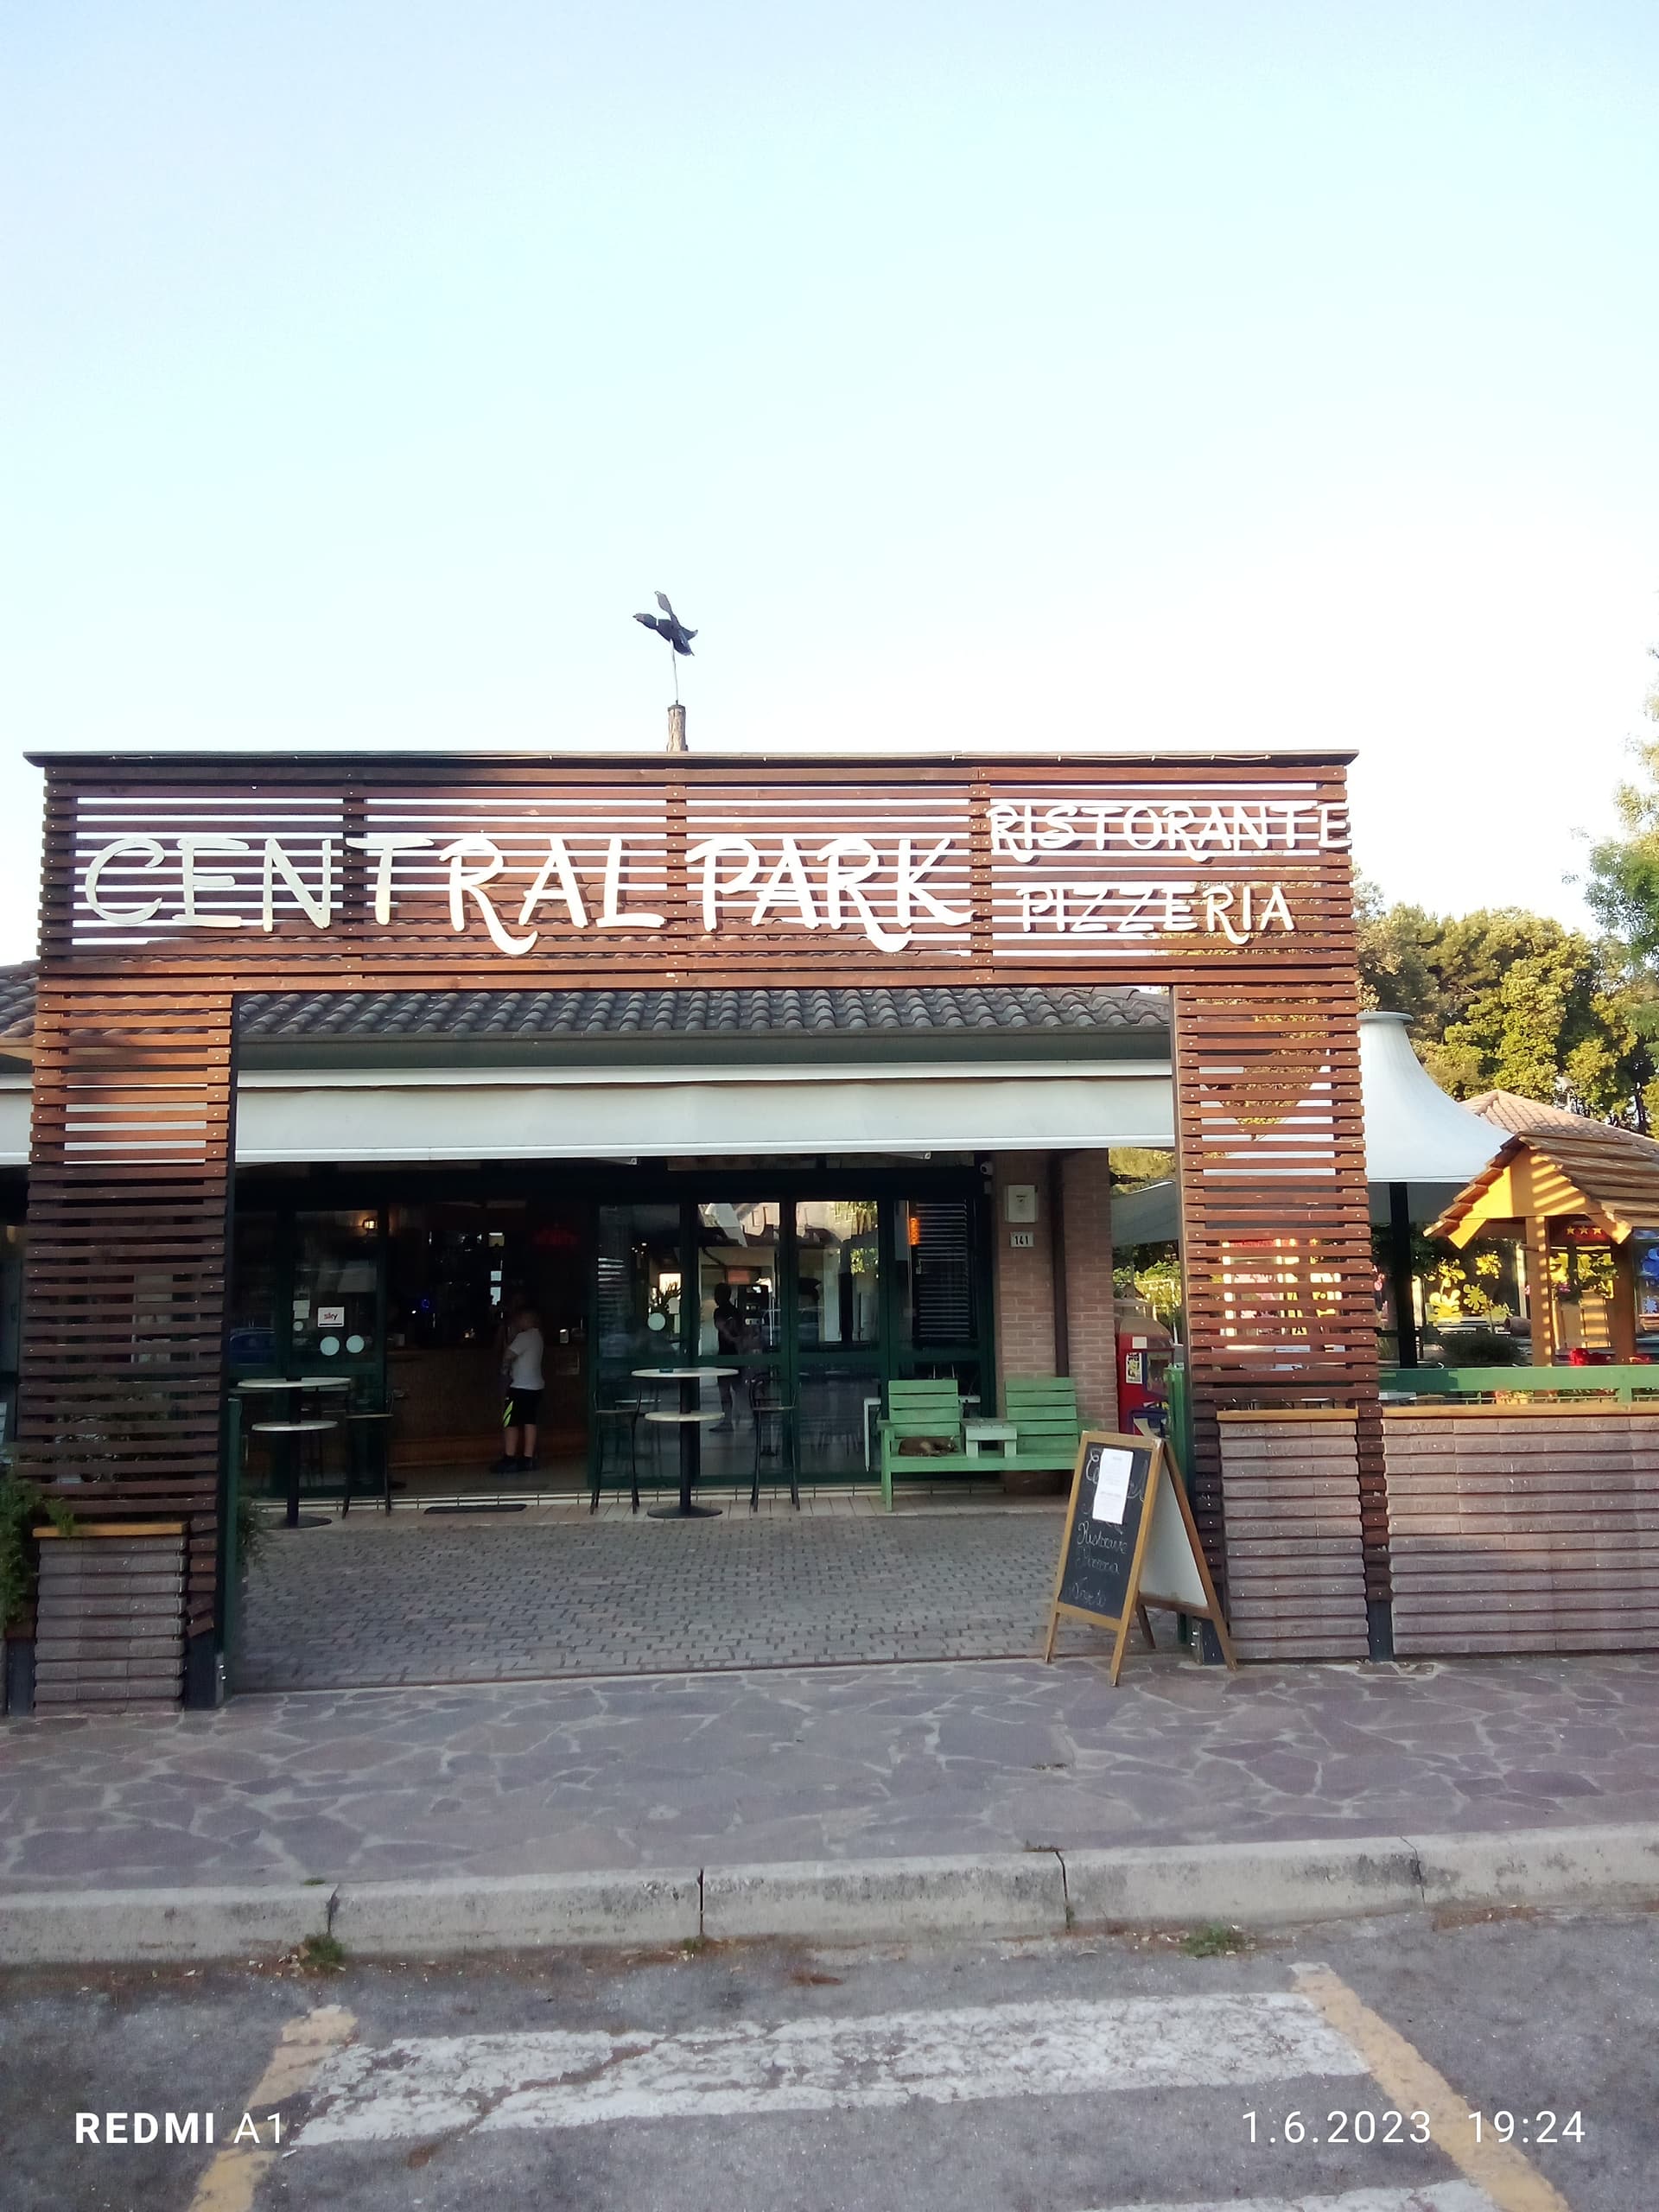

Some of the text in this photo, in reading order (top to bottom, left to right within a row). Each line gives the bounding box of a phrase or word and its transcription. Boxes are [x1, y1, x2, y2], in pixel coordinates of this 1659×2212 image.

[985, 802, 1352, 862] RISTORANTE
[86, 836, 978, 956] CENTRAL PARK
[1016, 883, 1297, 944] PIZZERIA
[1015, 1236, 1028, 1245] 141
[324, 1313, 339, 1321] sky
